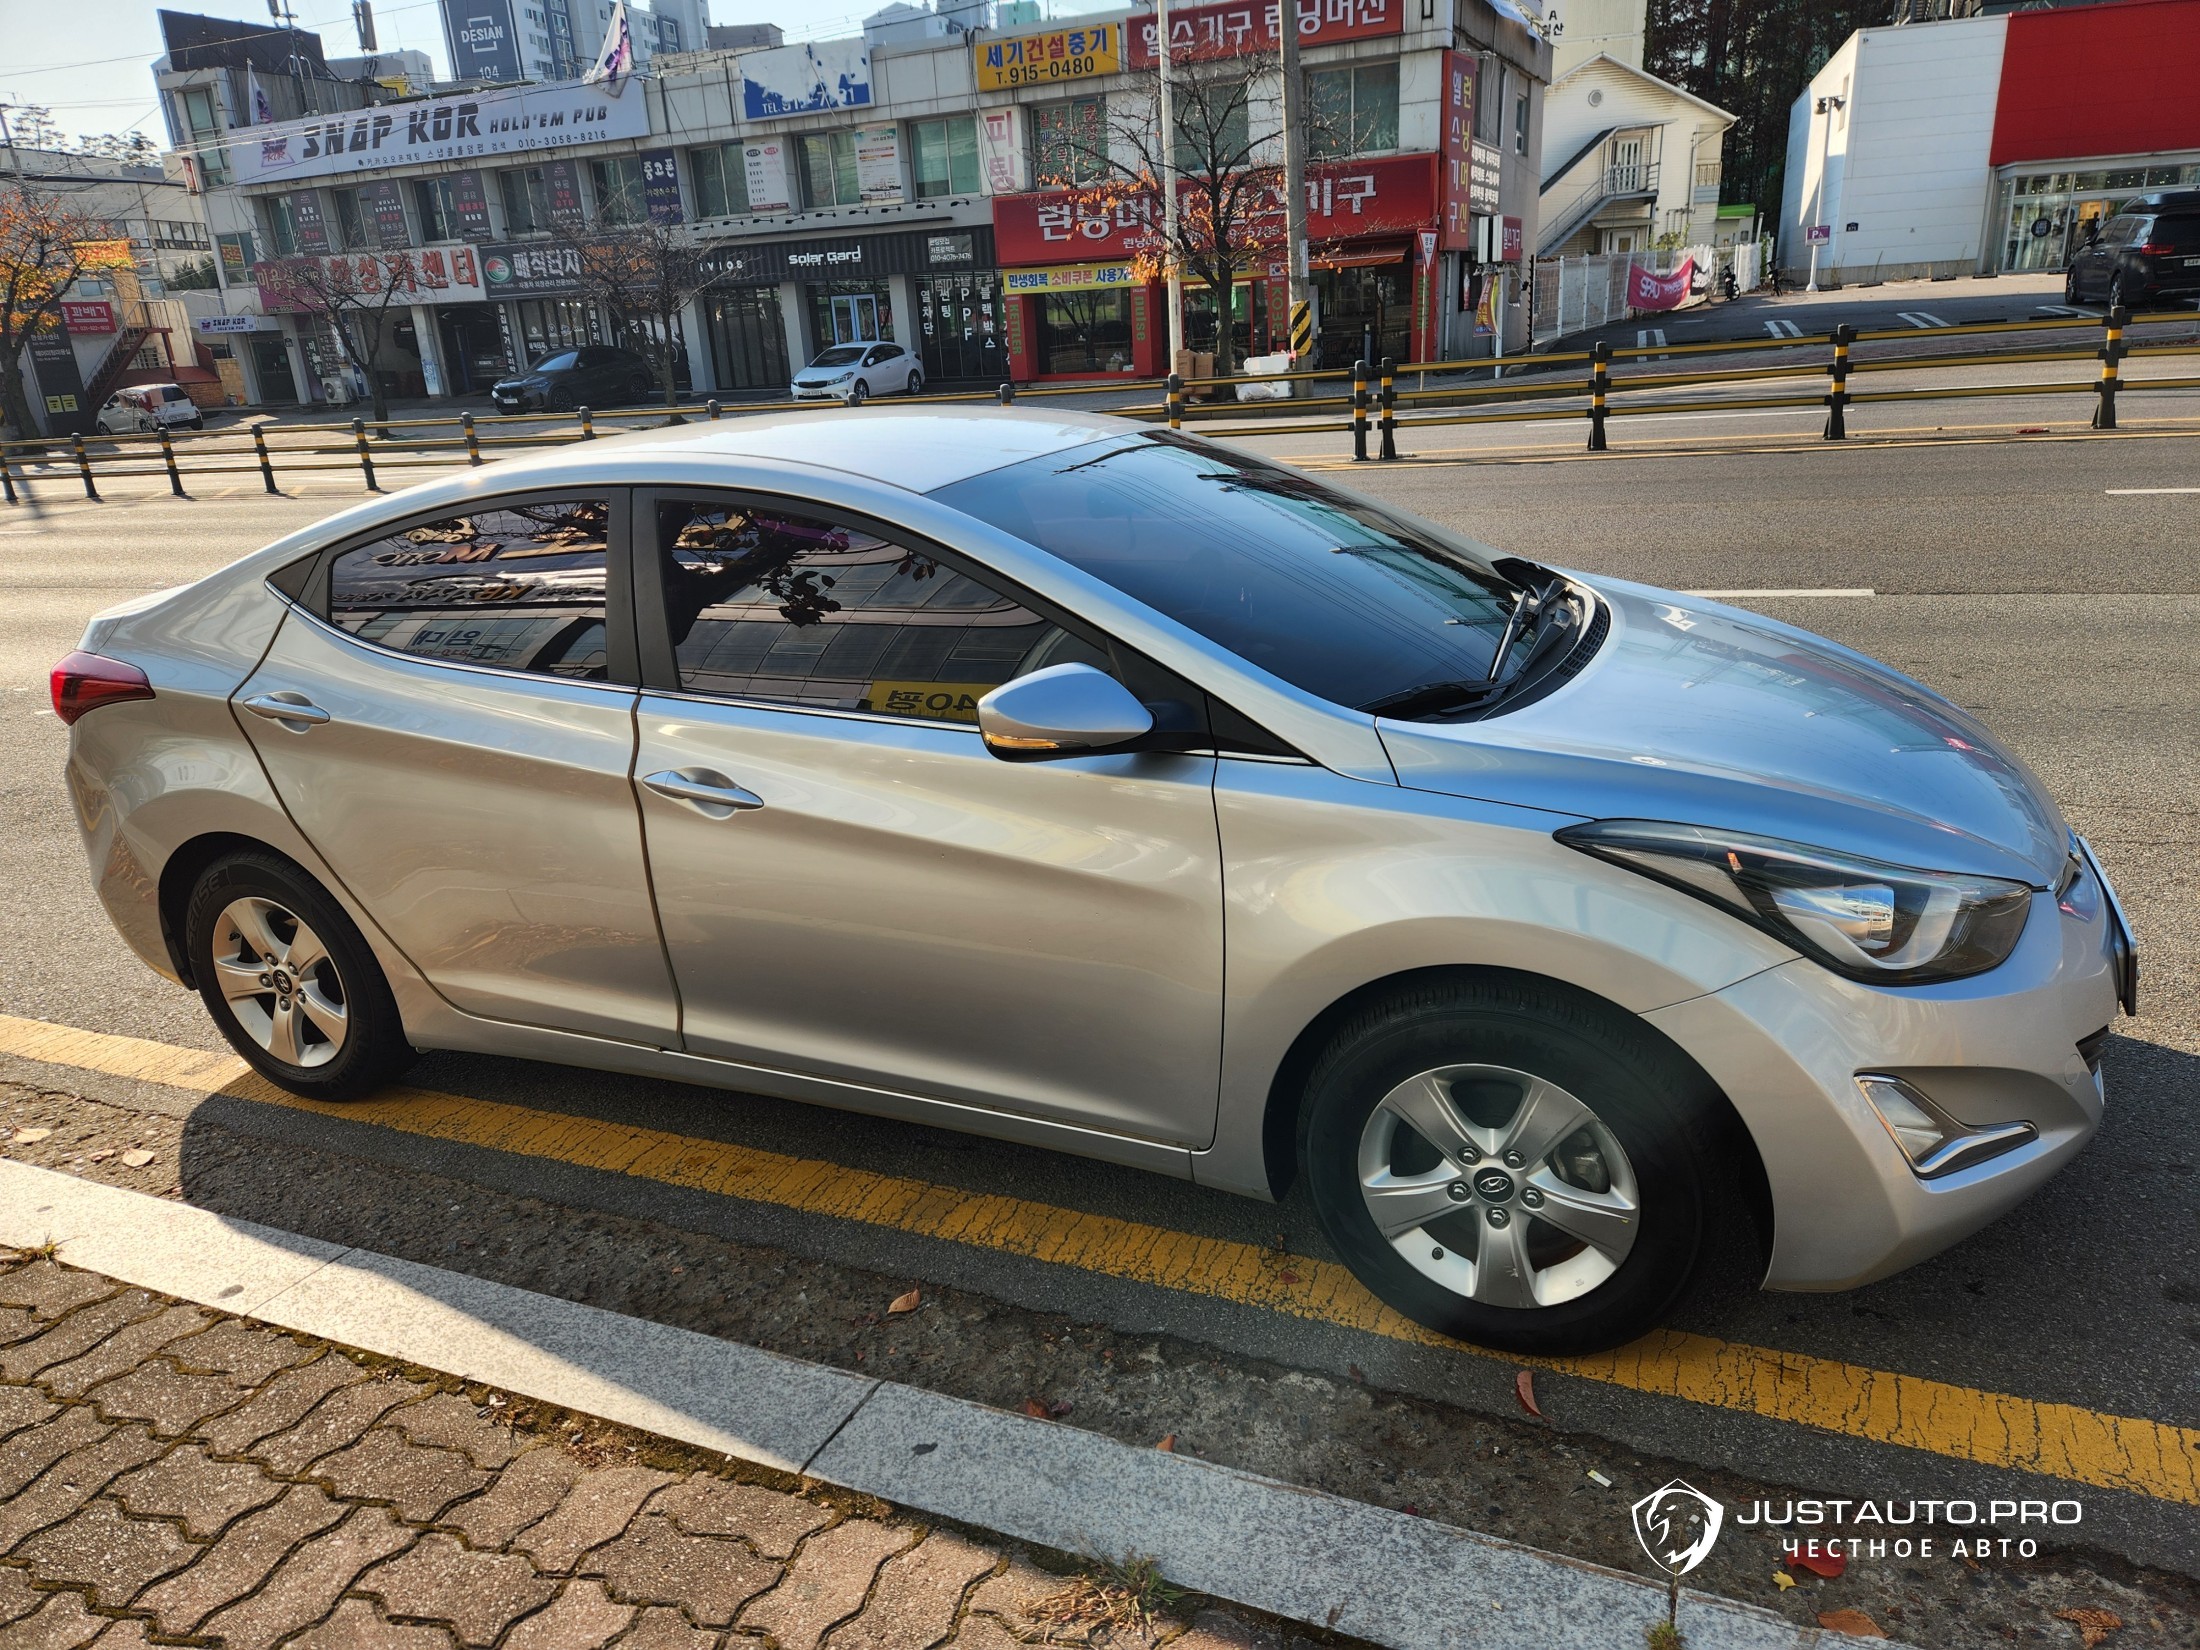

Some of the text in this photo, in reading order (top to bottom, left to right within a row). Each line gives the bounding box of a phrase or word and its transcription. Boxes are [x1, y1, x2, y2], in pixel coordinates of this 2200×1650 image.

[461, 26, 504, 43] DESIAN
[986, 27, 1108, 68] 세기건설중기
[479, 65, 500, 79] 104
[303, 115, 393, 159] SNAP
[408, 103, 482, 145] KOR
[573, 106, 608, 124] PUB
[518, 130, 607, 149] 010-3058-8216
[986, 110, 1016, 192] 피팅
[1449, 70, 1462, 232] 헬스기구
[643, 158, 675, 181] 중고폰
[1460, 75, 1474, 233] 런닝머신
[788, 245, 862, 265] Solar Gard
[1008, 272, 1049, 288] 민생회복
[1052, 269, 1092, 286] 소비쿠폰
[72, 303, 107, 318] 꽈배기
[920, 290, 934, 336] 열차단
[980, 286, 995, 350] 블랙박스
[1009, 304, 1022, 355] KETTLER
